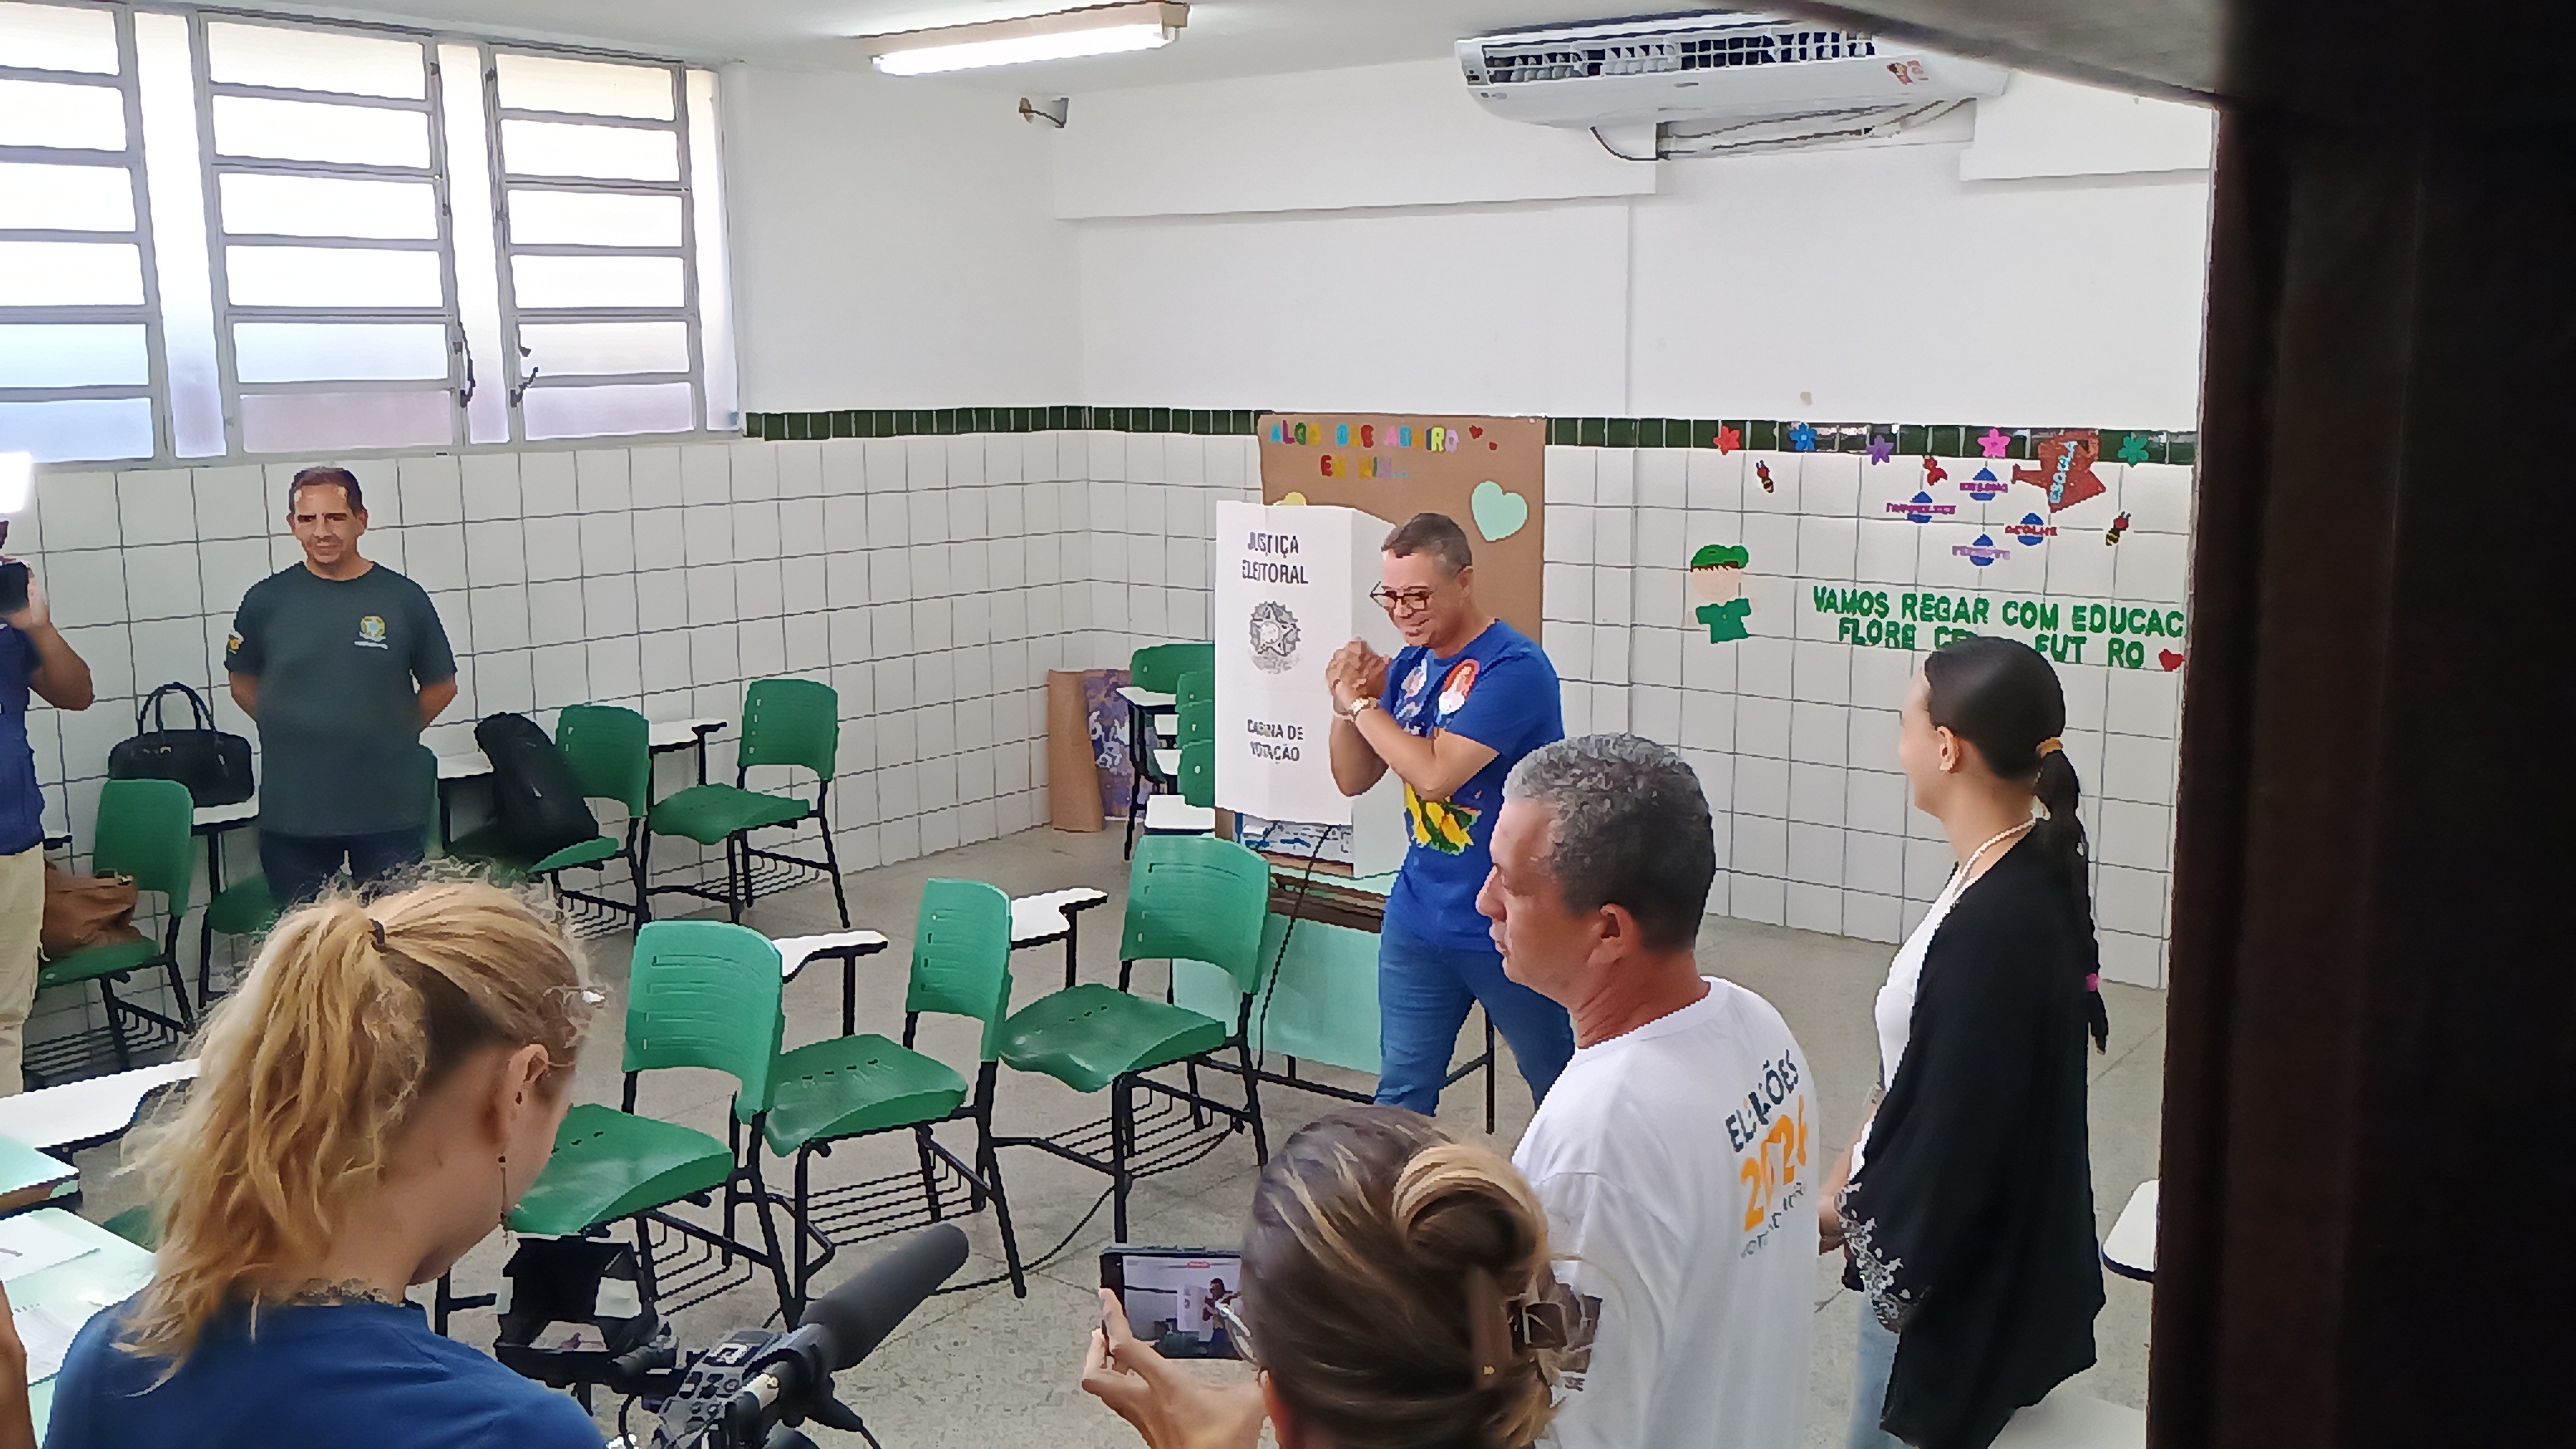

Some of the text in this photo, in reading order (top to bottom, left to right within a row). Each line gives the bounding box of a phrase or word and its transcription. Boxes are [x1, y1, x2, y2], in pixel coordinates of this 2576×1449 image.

[1243, 559, 1309, 584] ELEITORAL
[1814, 586, 1890, 619] VAMOS
[1902, 593, 1989, 624] REGAR
[2002, 601, 2058, 631] COM
[1287, 725, 1304, 740] DE
